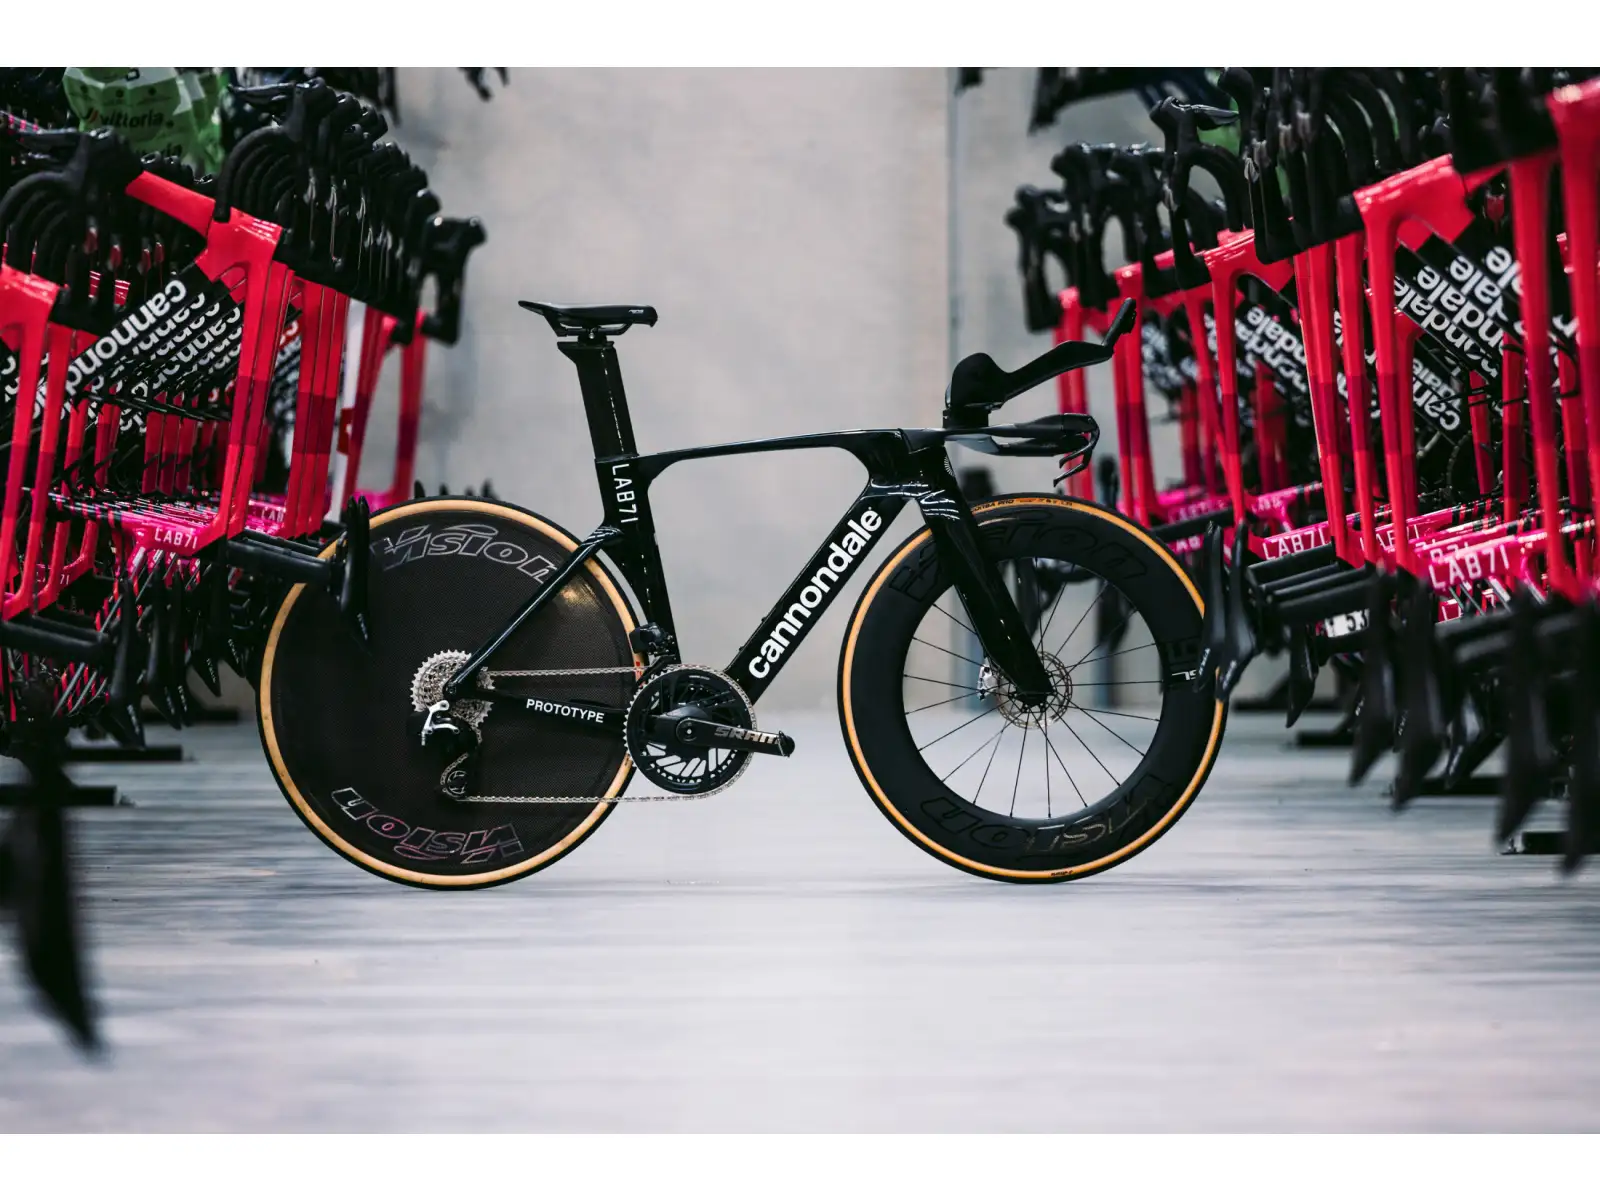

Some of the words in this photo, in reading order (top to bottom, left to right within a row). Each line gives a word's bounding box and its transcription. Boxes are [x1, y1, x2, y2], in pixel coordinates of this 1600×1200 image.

[612, 463, 639, 523] LAB71
[154, 526, 198, 549] LAB71
[1428, 543, 1510, 590] LAB71
[748, 509, 882, 679] cannondale
[525, 698, 605, 724] PROTOTYPE
[714, 726, 781, 746] SRAM
